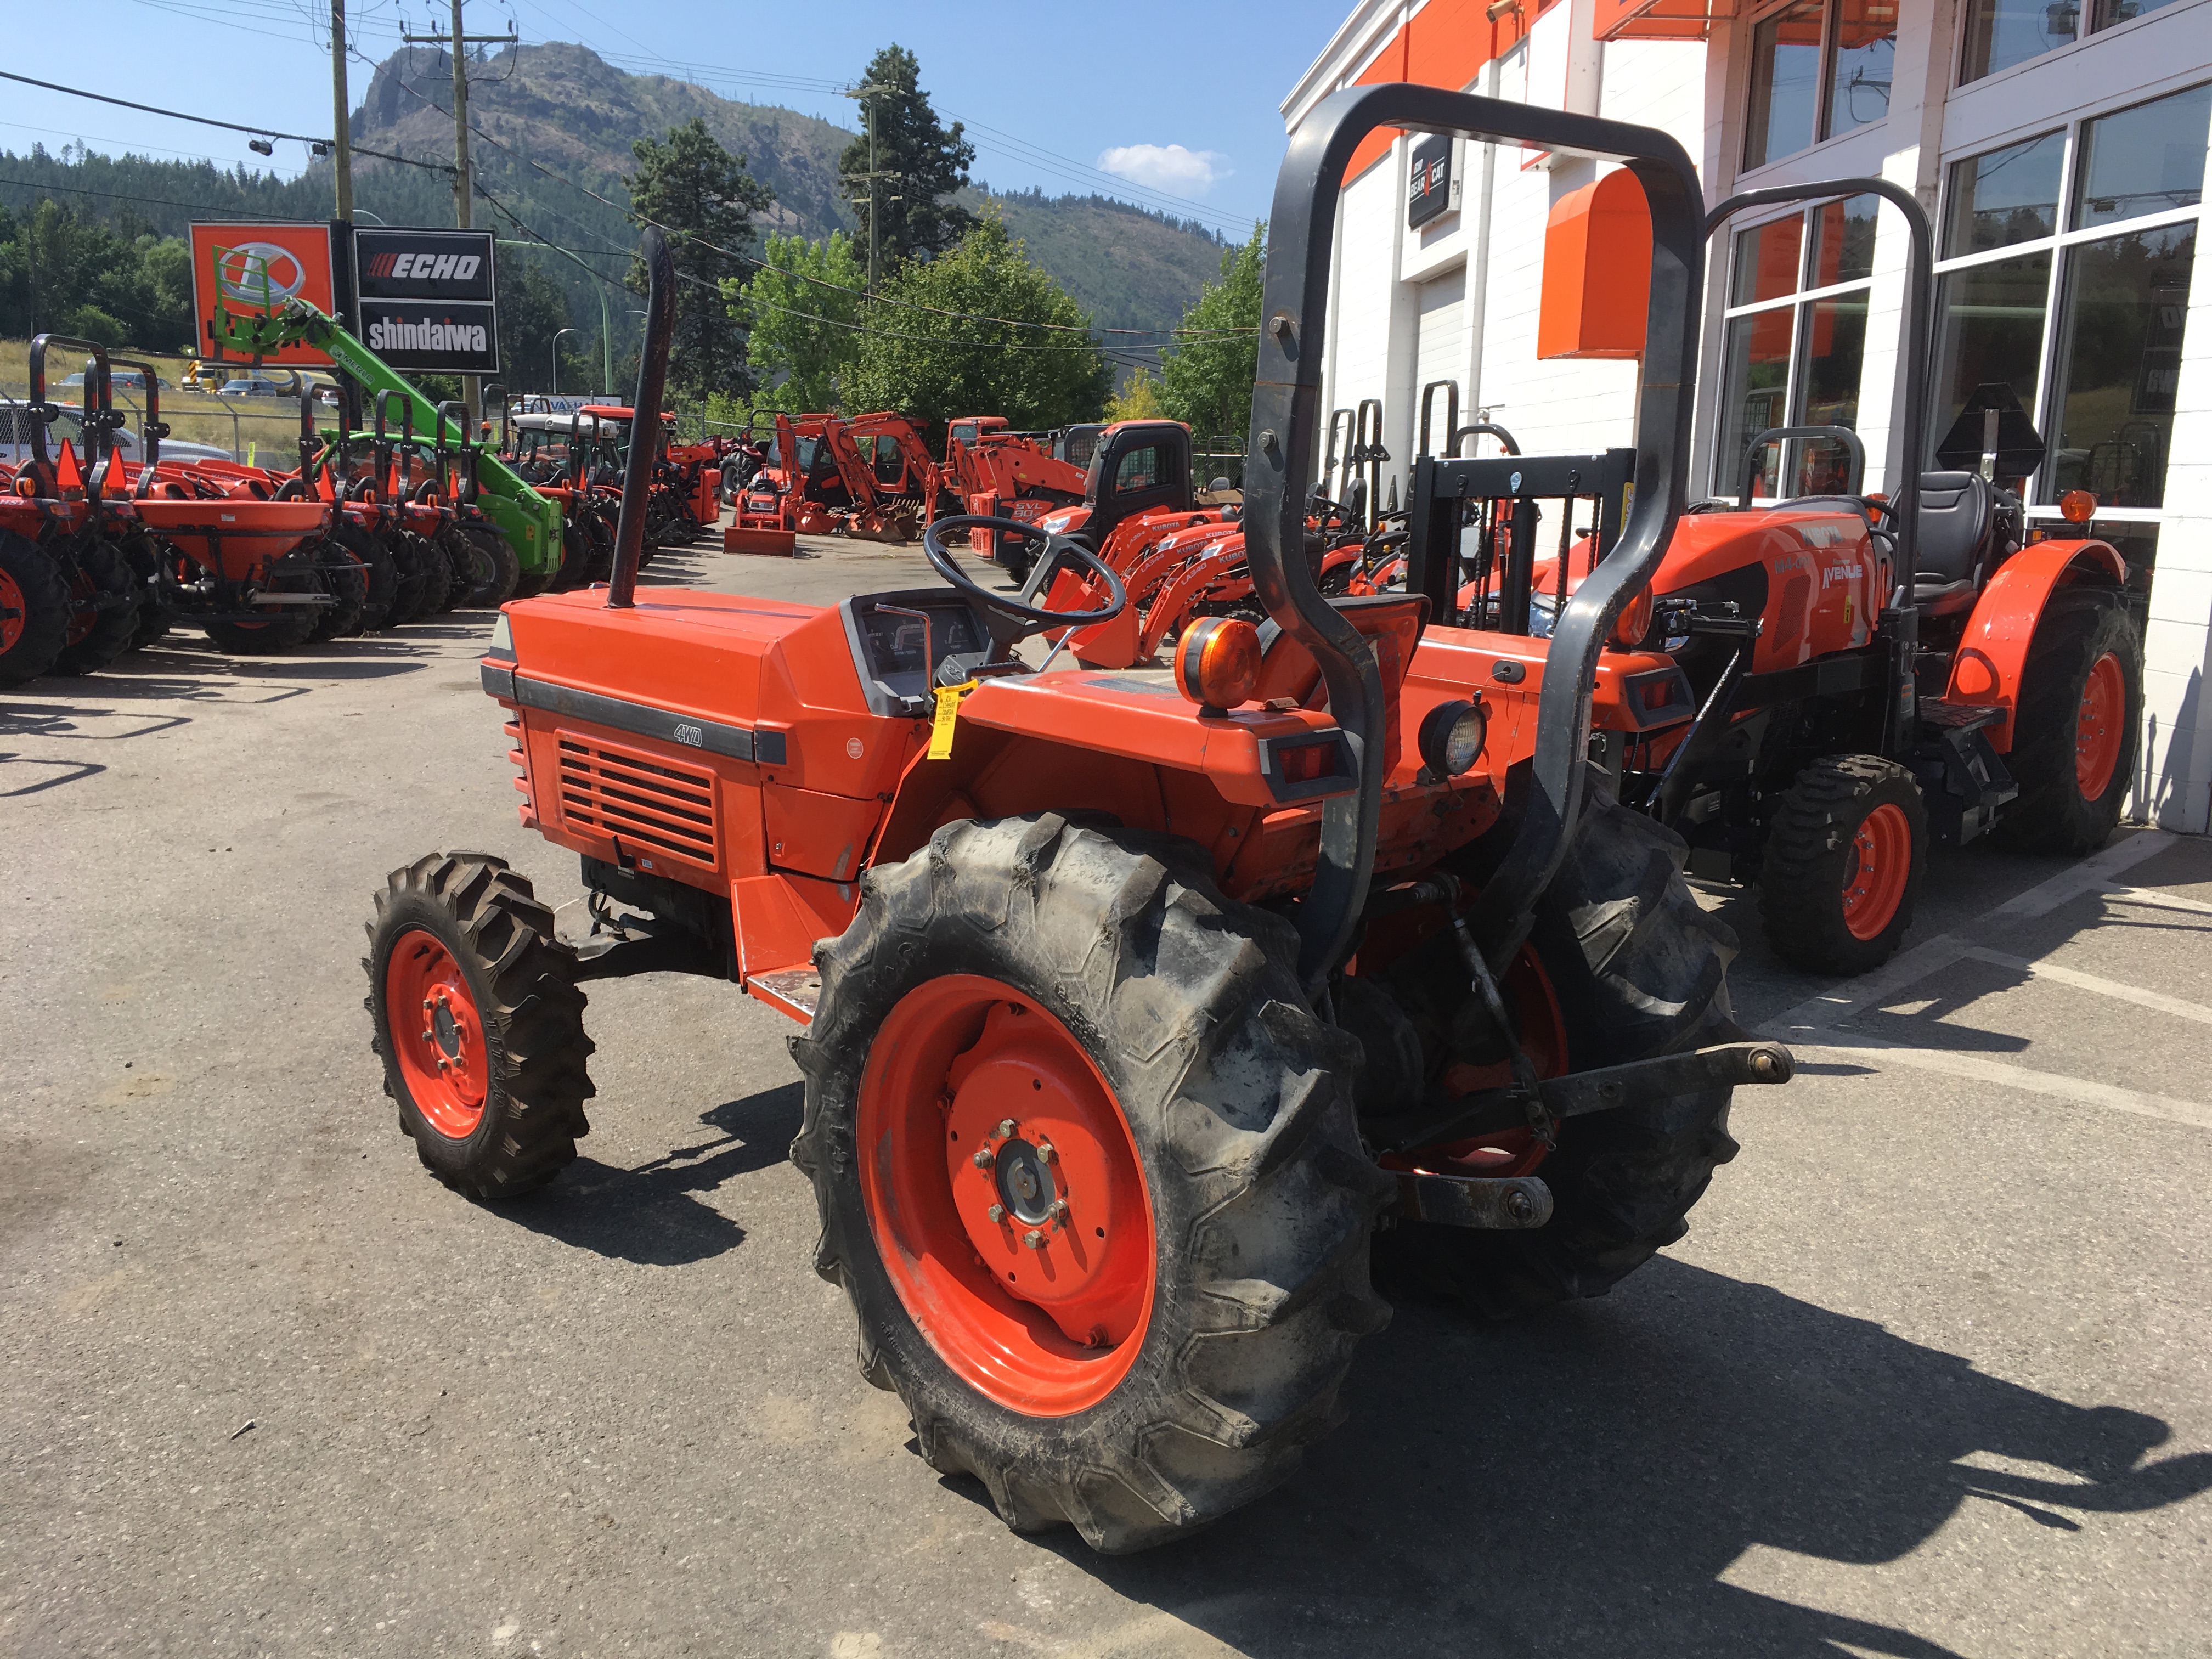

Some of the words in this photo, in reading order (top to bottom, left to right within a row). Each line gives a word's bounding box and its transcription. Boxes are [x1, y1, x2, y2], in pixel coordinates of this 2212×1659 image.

[1410, 176, 1425, 198] BEAR
[1431, 162, 1445, 183] CAT
[392, 253, 481, 280] ECHO
[369, 316, 486, 351] shindaiwa
[343, 356, 374, 382] MERLO
[1152, 522, 1180, 531] KUBOTA
[1799, 526, 1844, 546] KUBOTA
[1176, 540, 1209, 555] KUBOTA
[1141, 553, 1165, 573] LA344
[1181, 562, 1207, 585] LA340
[1822, 564, 1863, 589] AVENUE
[674, 723, 703, 747] 4WD
